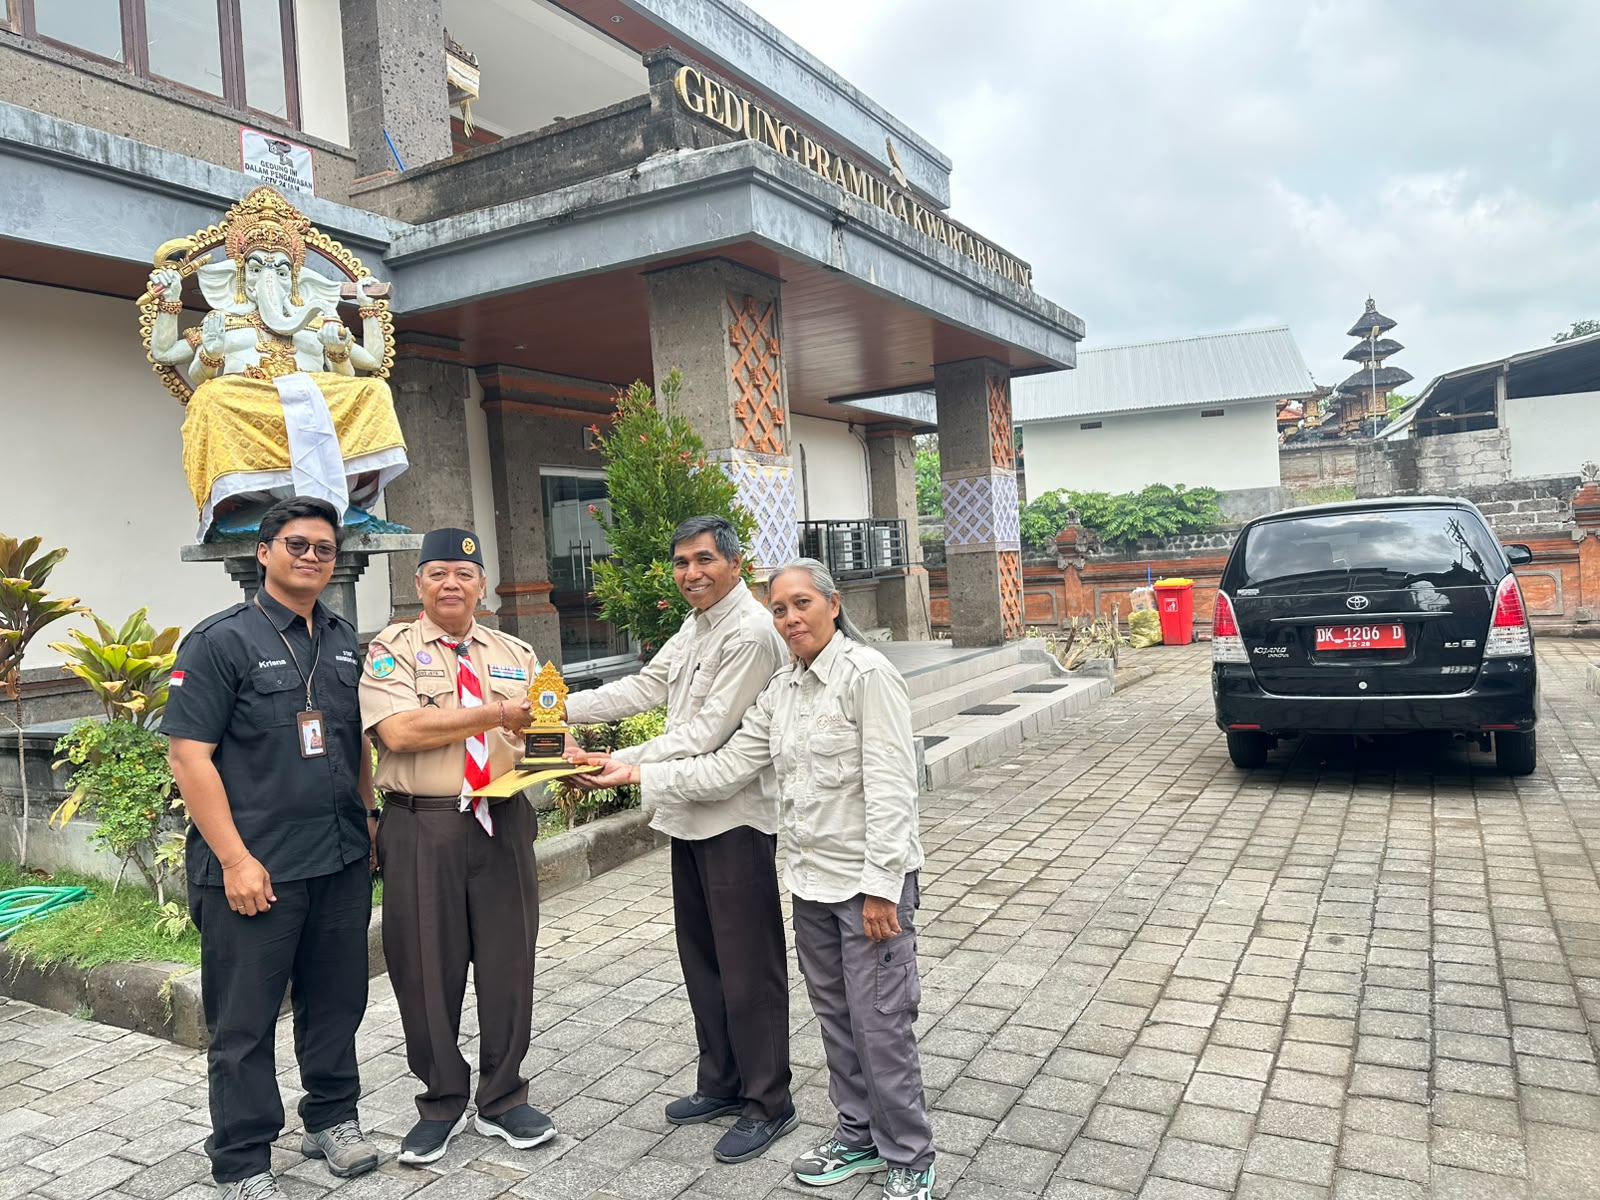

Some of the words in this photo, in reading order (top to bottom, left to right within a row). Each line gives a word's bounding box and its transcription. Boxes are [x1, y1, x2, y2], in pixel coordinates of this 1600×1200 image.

[674, 65, 799, 163] GEDUNG
[801, 134, 909, 225] PRAMUKA
[244, 163, 269, 175] DALAM
[270, 171, 313, 189] PENGAWASAN
[260, 160, 289, 174] GEDUNG
[289, 169, 298, 177] INI
[260, 175, 278, 185] CCTV
[1316, 627, 1335, 643] DK
[1344, 626, 1380, 641] 1206
[1392, 625, 1402, 640] D
